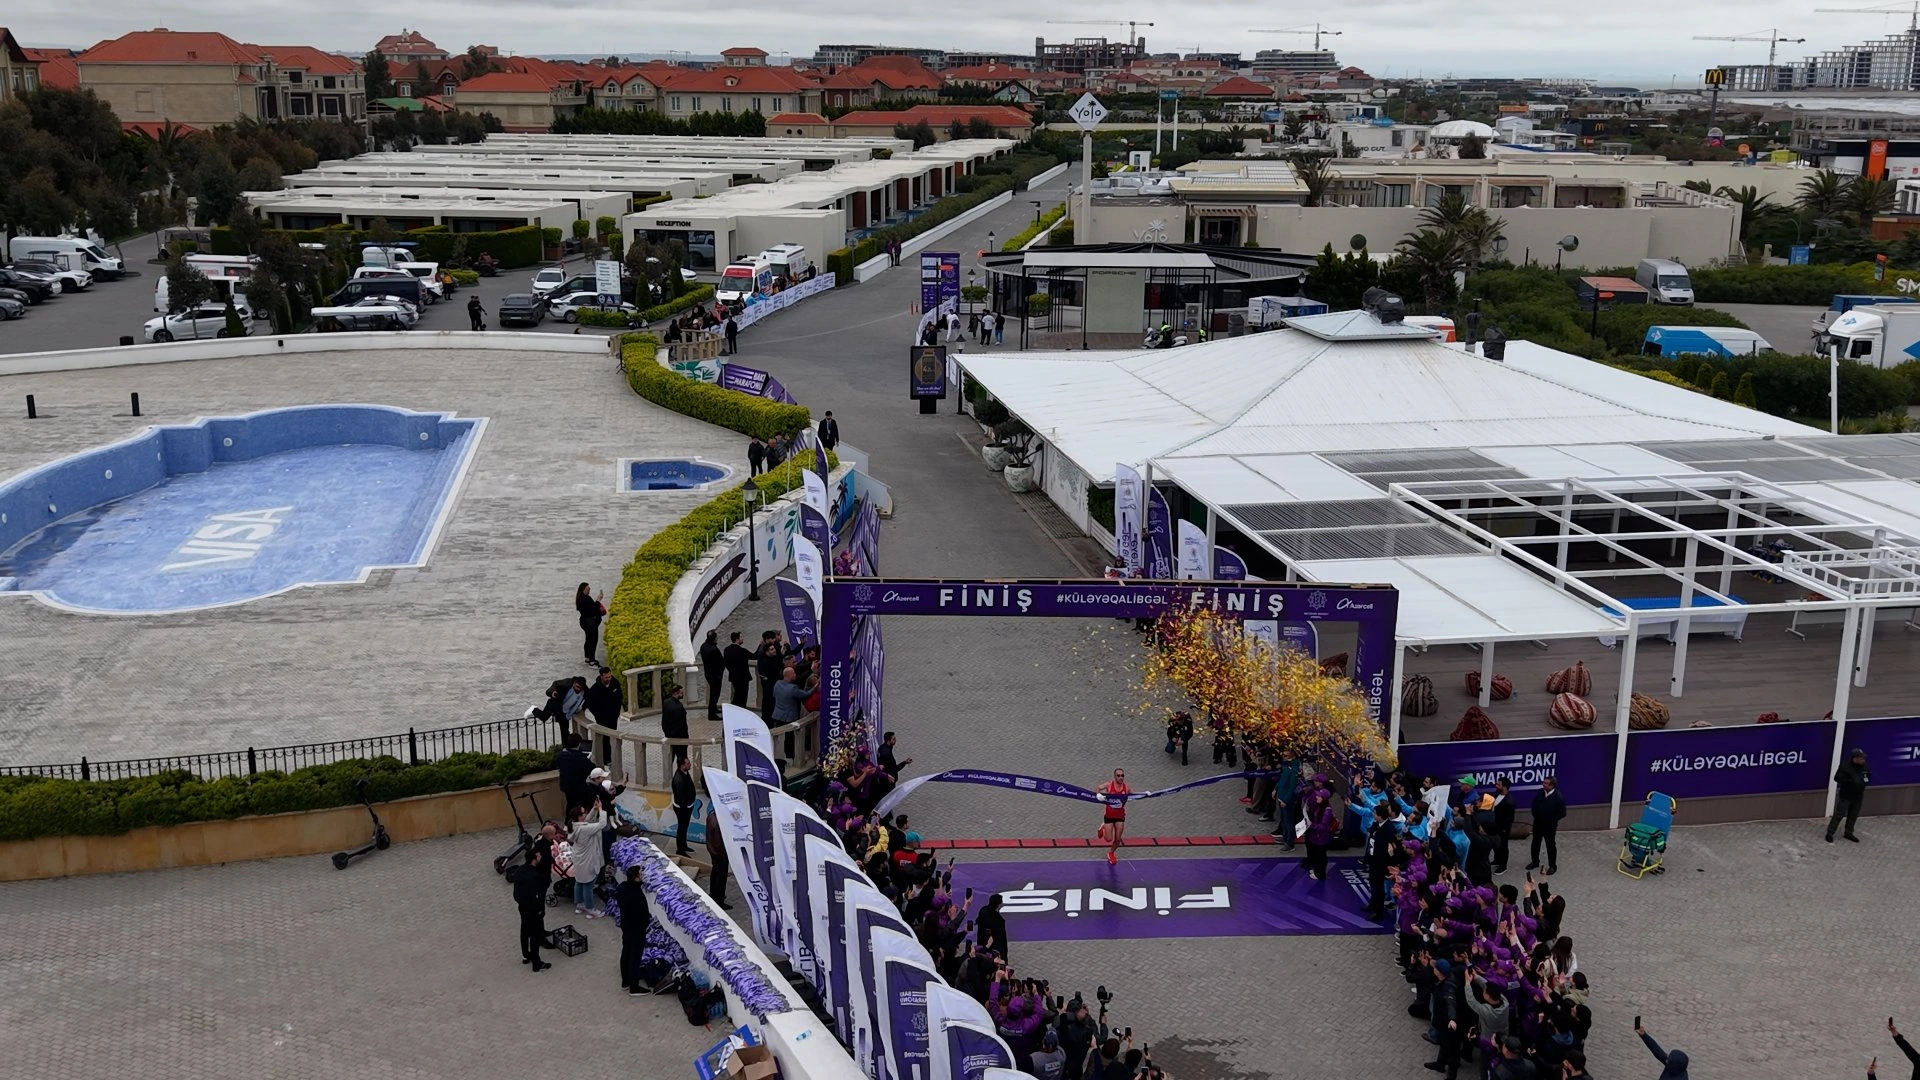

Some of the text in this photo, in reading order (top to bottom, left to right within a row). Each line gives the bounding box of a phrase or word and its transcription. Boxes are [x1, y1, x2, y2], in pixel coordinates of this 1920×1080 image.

[1075, 105, 1102, 119] Yolo
[733, 377, 764, 391] MARAFONU
[753, 372, 767, 382] BAKI
[160, 506, 293, 572] VISA
[719, 567, 734, 589] NEW
[939, 585, 1033, 613] FİNİŞ
[1056, 593, 1168, 605] #KÜLƏYƏQALİBGƏL
[1190, 588, 1284, 618] FİNİŞ
[1524, 752, 1557, 768] BAKI
[1650, 750, 1807, 773] #KÜLƏYƏQALİBGƏL
[1475, 768, 1556, 786] MARAFONU
[998, 882, 1231, 918] FİNİŞ
